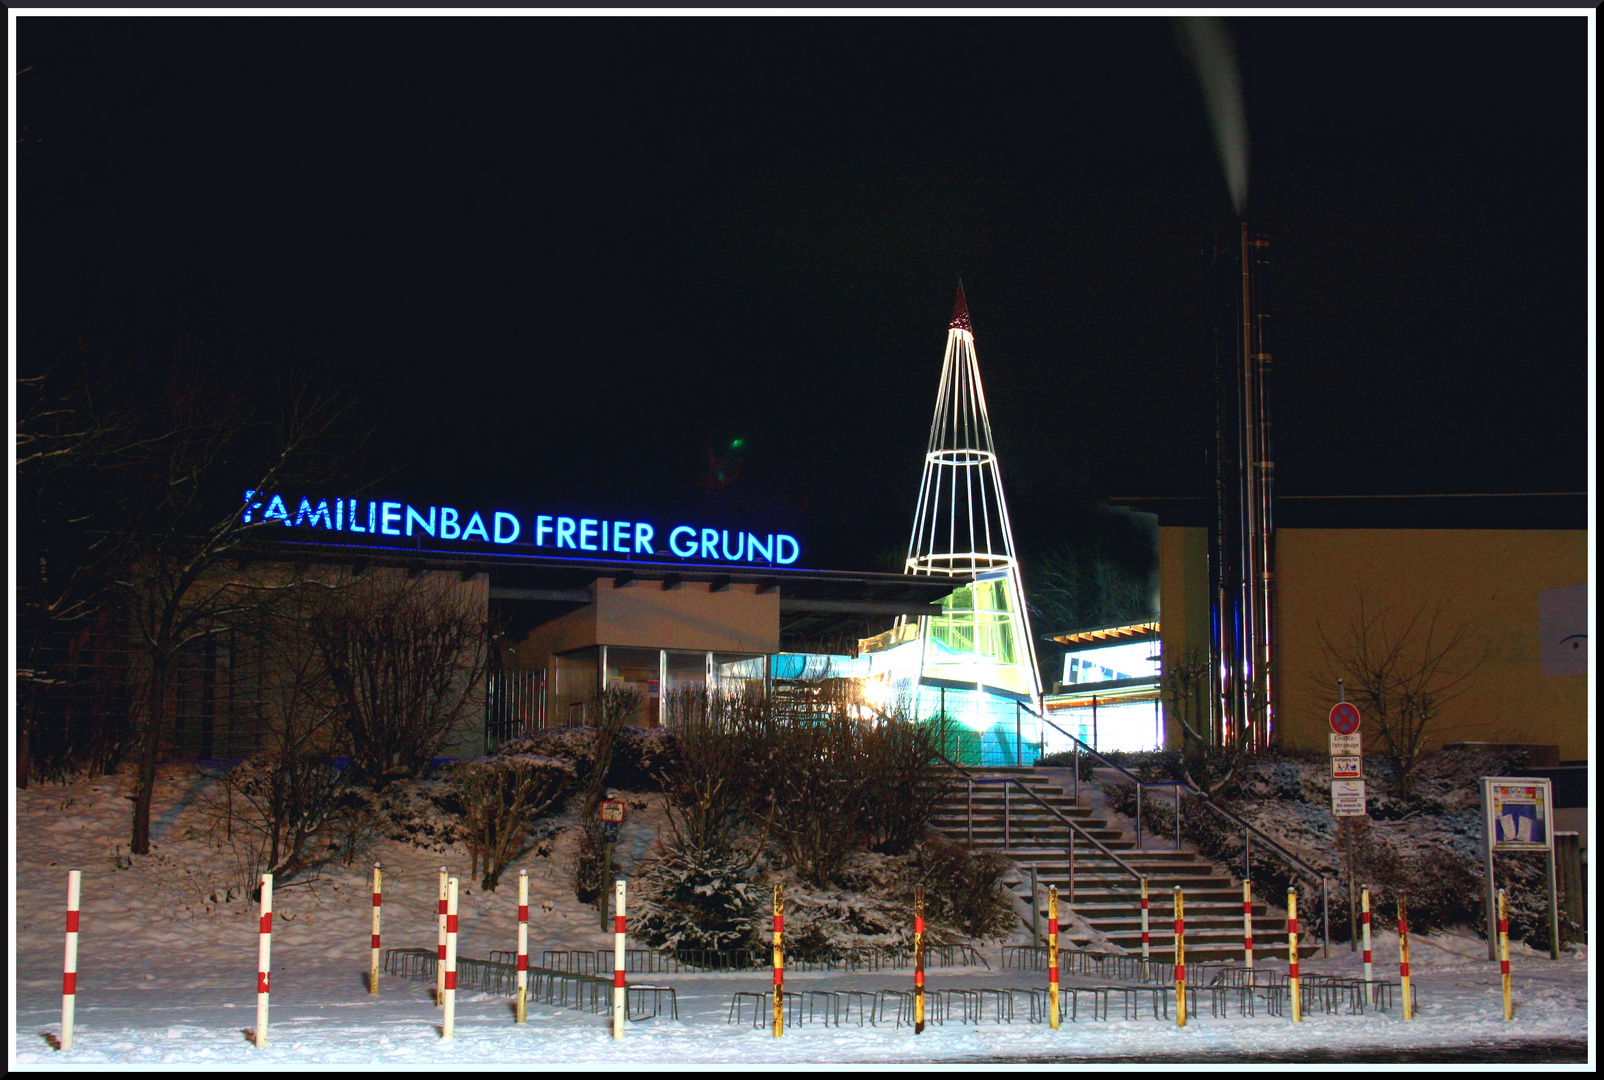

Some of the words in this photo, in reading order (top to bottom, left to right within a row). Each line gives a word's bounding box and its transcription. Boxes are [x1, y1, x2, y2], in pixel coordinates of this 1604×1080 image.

[241, 488, 521, 545] FAMILIENBAD
[535, 514, 655, 555] FREIER
[668, 524, 800, 565] GRUND
